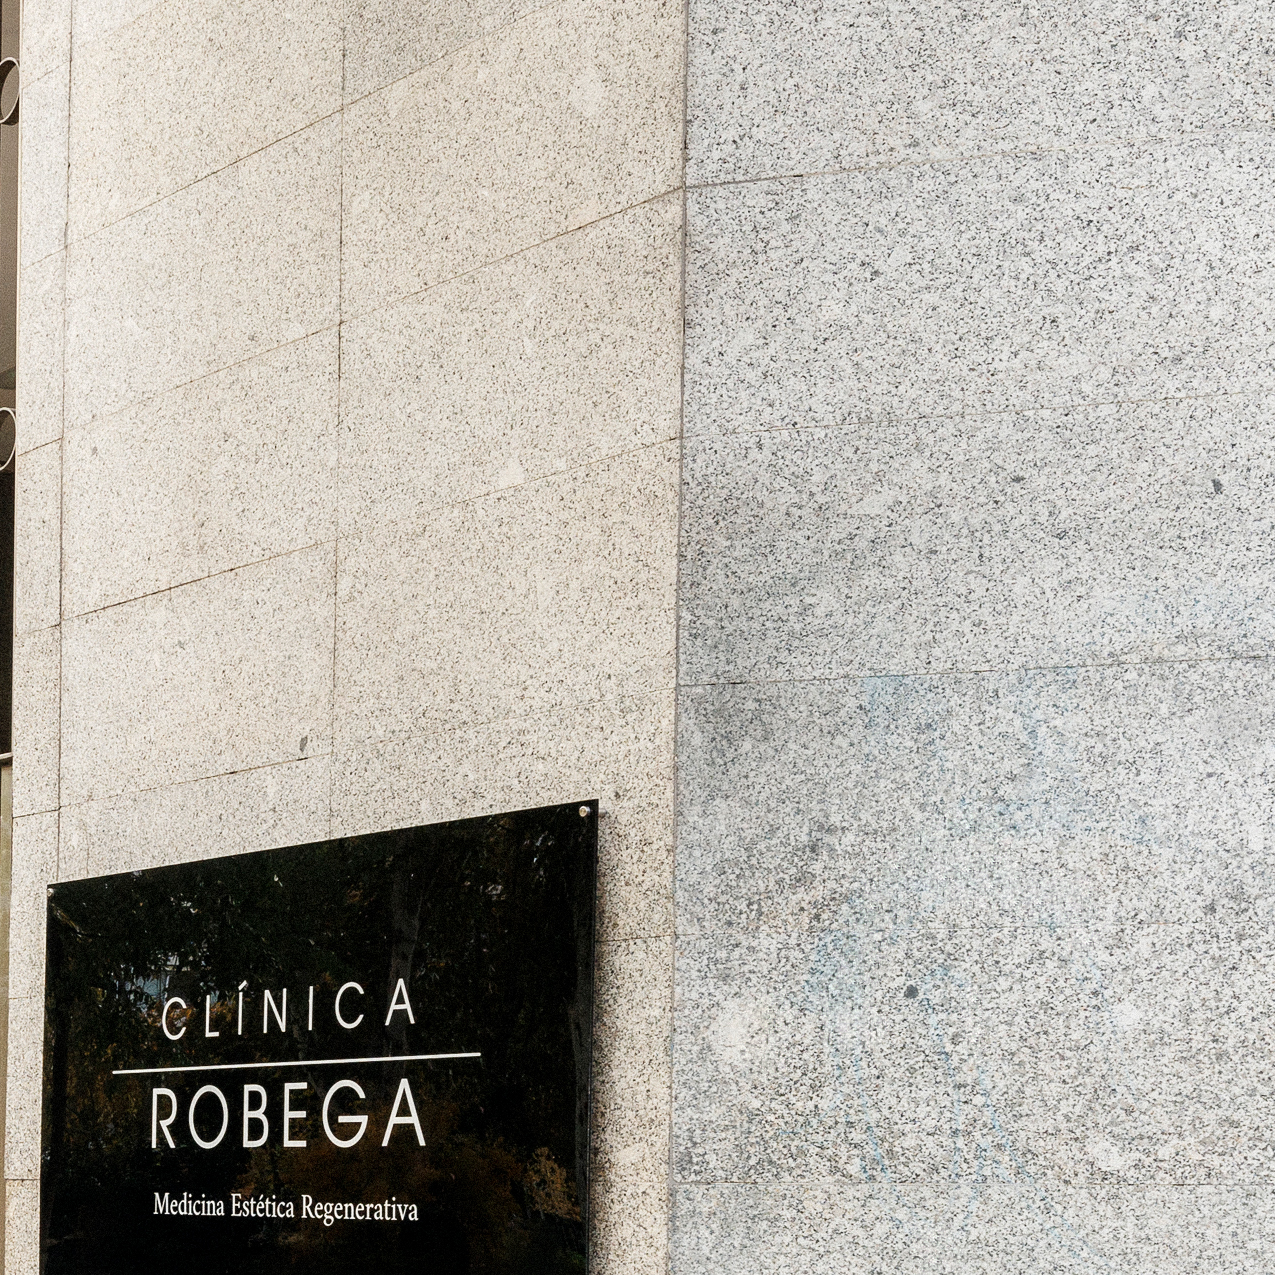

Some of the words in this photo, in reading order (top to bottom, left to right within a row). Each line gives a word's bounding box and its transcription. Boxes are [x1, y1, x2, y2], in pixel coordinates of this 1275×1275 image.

[161, 978, 416, 1041] CLÍNICA
[151, 1078, 427, 1150] ROBEGA
[153, 1192, 225, 1216] Medicina
[230, 1194, 295, 1218] Estética
[300, 1194, 419, 1227] Regenerativa
